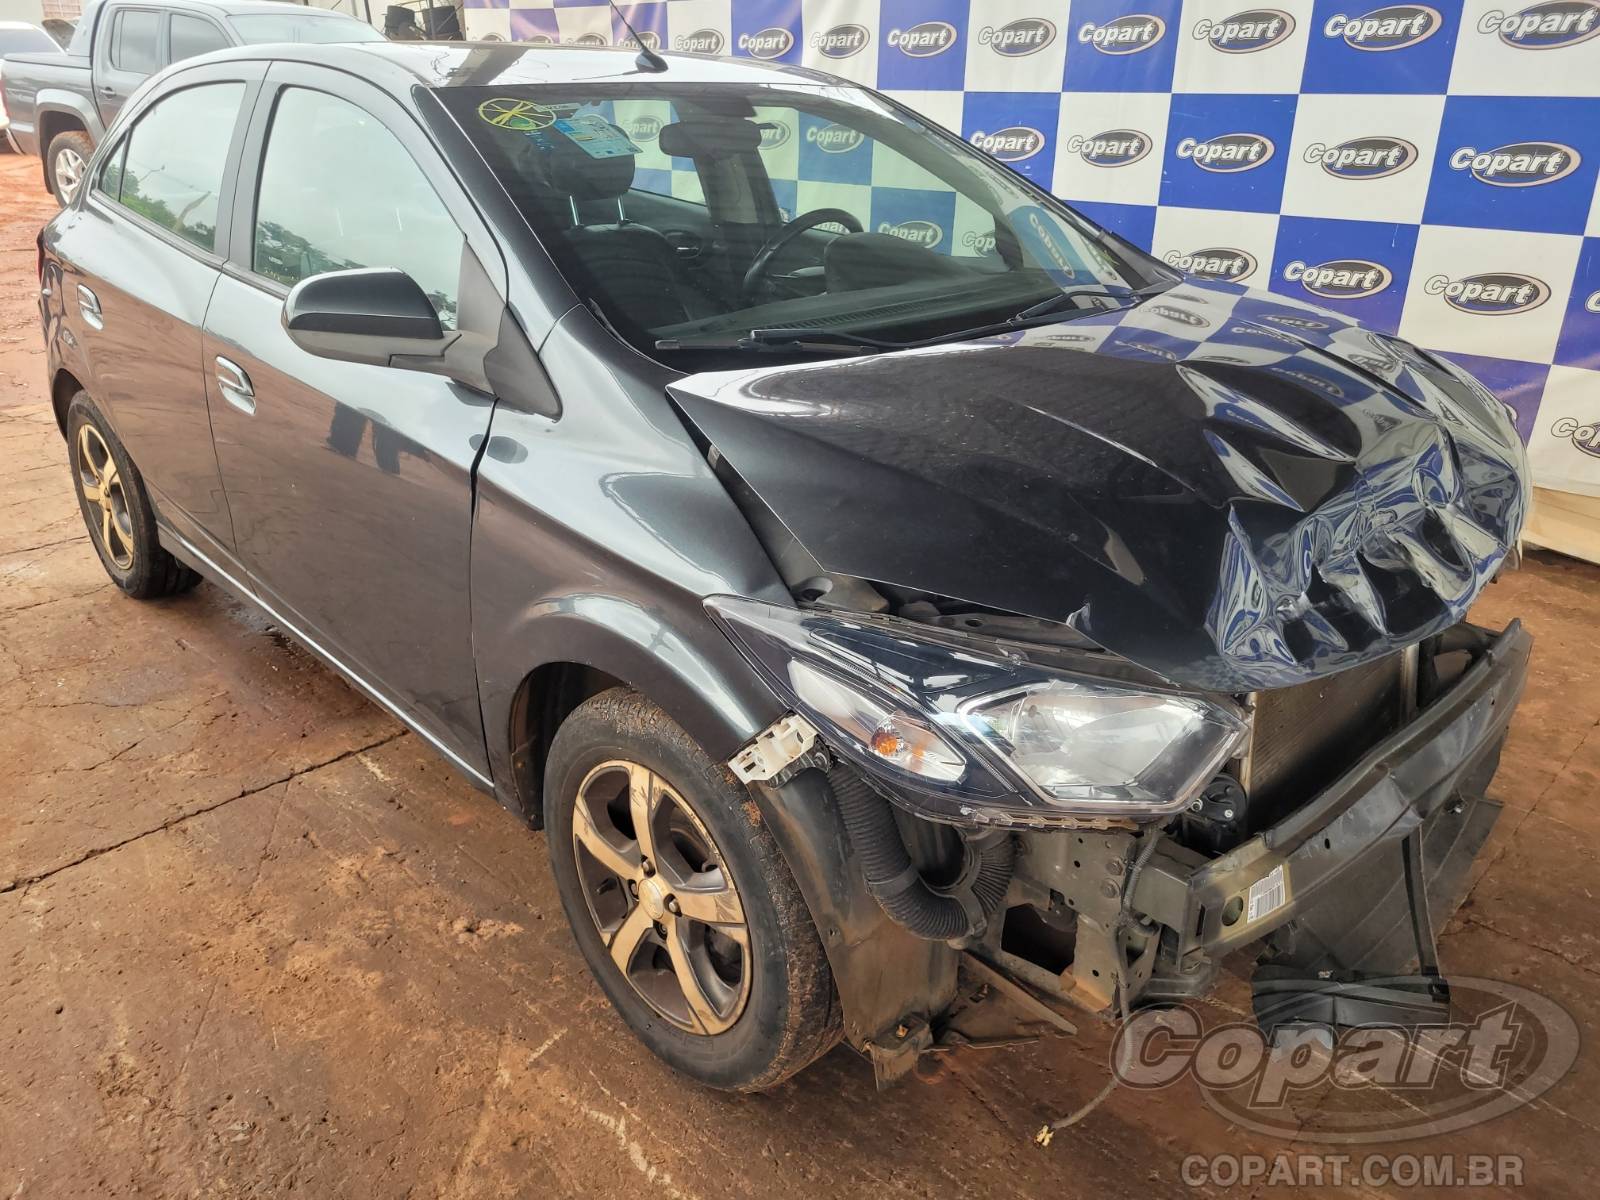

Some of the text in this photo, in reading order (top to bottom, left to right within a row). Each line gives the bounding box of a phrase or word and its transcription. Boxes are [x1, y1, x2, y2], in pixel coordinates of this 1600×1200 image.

[1079, 22, 1156, 45] Copart
[1192, 19, 1283, 44] Copart
[1324, 11, 1427, 41] Copart
[1477, 8, 1597, 40] Copart
[674, 35, 718, 51] Copart
[737, 33, 786, 51] Copart
[810, 31, 862, 49] Copart
[887, 28, 948, 48] Copart
[977, 25, 1046, 48] Copart
[806, 126, 857, 144] Copart
[970, 131, 1034, 154] Copart
[1067, 135, 1144, 159] Copart
[1176, 138, 1263, 163] Copart
[1303, 143, 1404, 169] Copart
[1449, 148, 1566, 176] Copart
[1163, 250, 1244, 275] Copart
[1283, 260, 1379, 290] Copart
[1424, 274, 1533, 304] Copart
